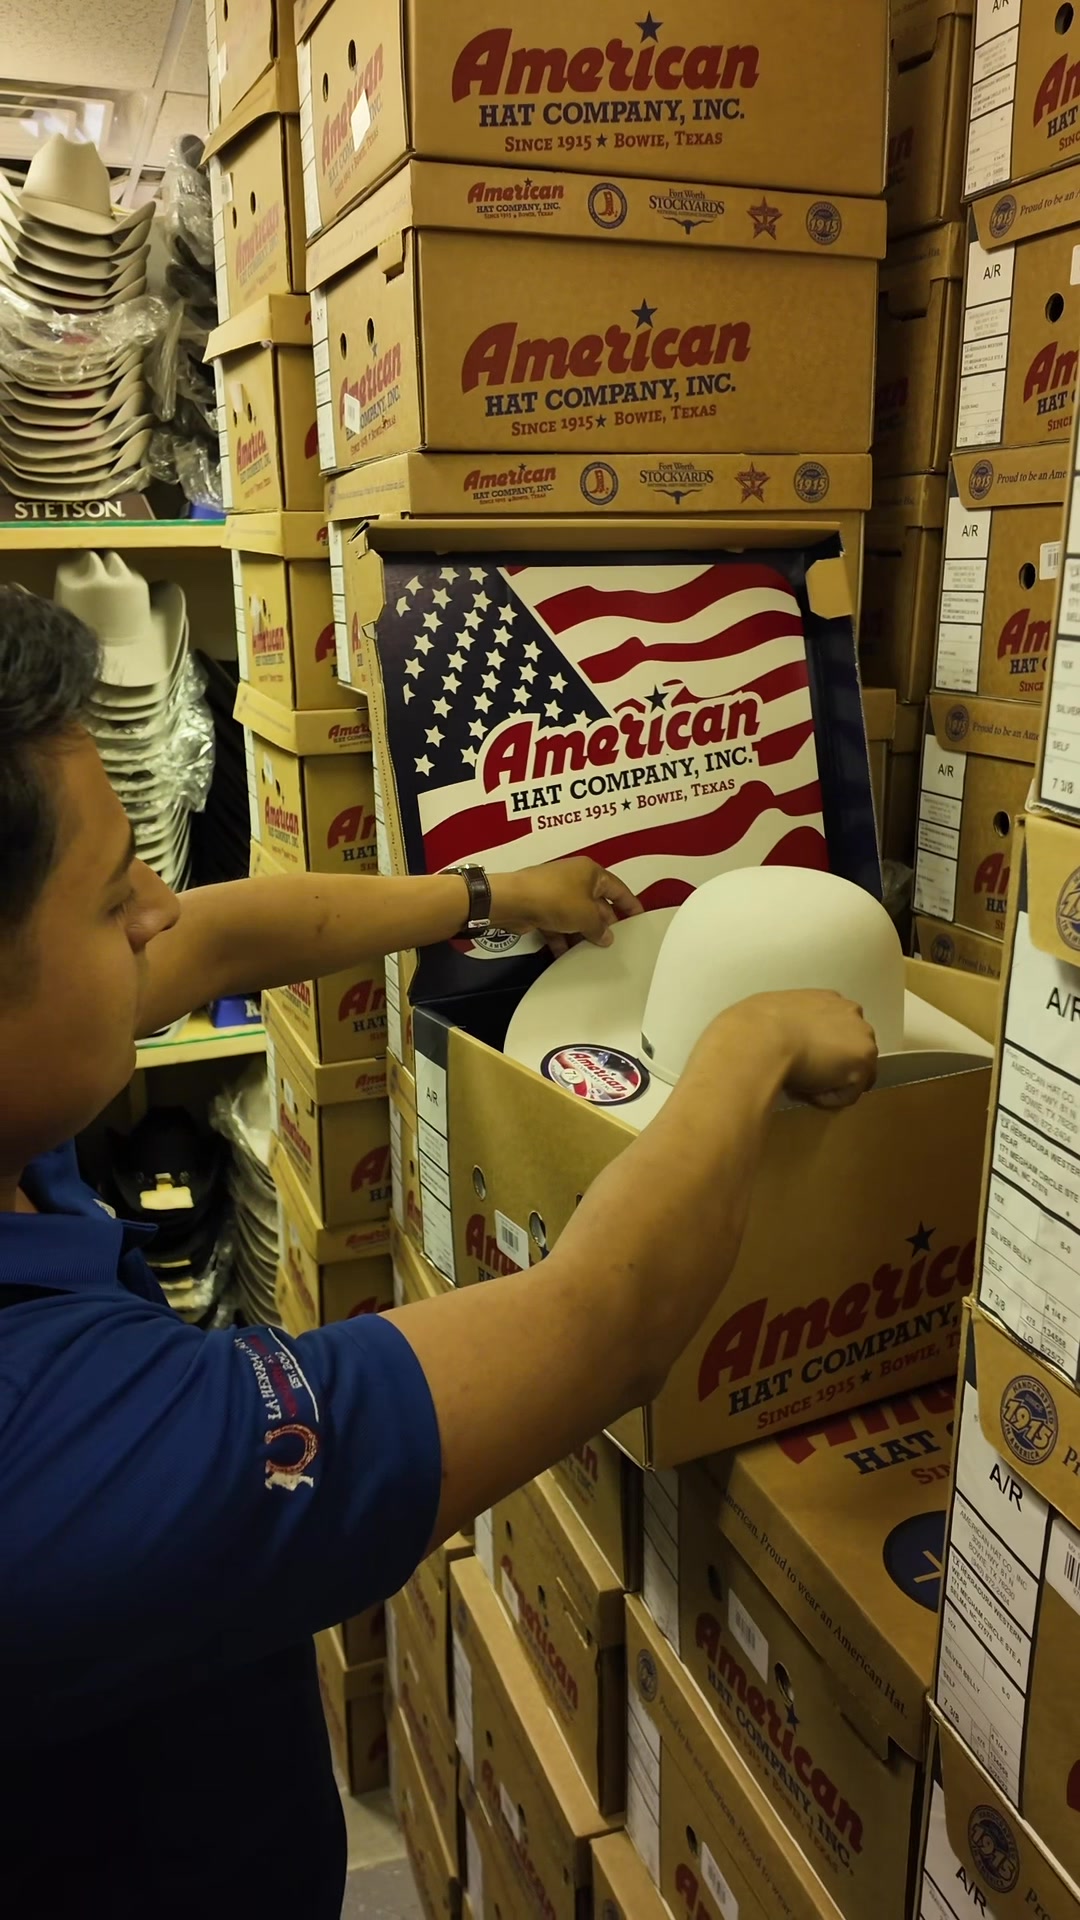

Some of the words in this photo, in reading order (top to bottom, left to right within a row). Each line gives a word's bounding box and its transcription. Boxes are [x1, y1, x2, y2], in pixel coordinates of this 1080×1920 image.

[452, 28, 760, 103] American
[479, 103, 535, 127] HAT
[543, 98, 685, 125] COMPANY,
[692, 98, 745, 121] INC.
[1047, 105, 1078, 139] HAT
[467, 182, 564, 203] American
[649, 195, 725, 215] STOCKYARDS
[669, 188, 683, 199] Fort
[684, 190, 706, 200] Worth
[1019, 199, 1043, 216] Proud
[1044, 199, 1053, 209] to
[1053, 195, 1064, 205] be
[1065, 191, 1075, 201] an
[810, 216, 839, 233] 1915
[983, 263, 1001, 280] A/R
[461, 321, 751, 394] American
[485, 391, 538, 417] HAT
[545, 378, 681, 411] COMPANY,
[685, 373, 736, 397] INC.
[1037, 391, 1068, 416] HAT
[639, 470, 714, 484] STOCKYARDS
[658, 462, 673, 471] Fort
[997, 472, 1018, 484] Proud
[1019, 473, 1026, 482] to
[1027, 472, 1037, 480] be
[463, 467, 556, 492] American
[798, 477, 826, 491] 1915
[971, 473, 992, 489] 1915
[14, 501, 126, 519] STETSON
[962, 525, 978, 537] A/R
[1010, 658, 1038, 674] HAT
[972, 722, 992, 735] Proud
[993, 725, 1002, 735] to
[1003, 726, 1012, 735] be
[1012, 729, 1021, 737] an
[483, 698, 760, 794] American
[511, 784, 563, 812] HAT
[569, 756, 700, 800] COMPANY,
[705, 746, 753, 772] INC.
[937, 763, 954, 778] A/R
[1052, 778, 1058, 790] 7
[537, 811, 582, 830] SINCE
[585, 802, 617, 820] 1915
[636, 790, 688, 809] BOWIE,
[691, 779, 735, 797] TEXAS
[489, 935, 517, 948] AMERICA
[1011, 1061, 1045, 1087] AMERICAN
[1047, 1082, 1061, 1095] HAT
[426, 1086, 439, 1107] A/R
[1046, 1107, 1056, 1119] TX
[1000, 1132, 1018, 1148] WEAR
[1021, 1171, 1031, 1182] NC
[1051, 1151, 1080, 1178] WESTER
[1039, 1170, 1063, 1193] CIRCLE
[1064, 1188, 1079, 1203] STE
[991, 1227, 1012, 1249] SILVER
[1013, 1244, 1032, 1264] BELLY
[988, 1256, 1003, 1272] SELF
[988, 1288, 994, 1299] 7
[995, 1294, 1006, 1311] 3/8
[728, 1368, 792, 1416] HAT
[801, 1301, 958, 1384] COMPANY,
[1041, 1344, 1065, 1367] 5/25/22
[757, 1392, 811, 1430] SINCE
[816, 1376, 856, 1401] 1915
[1003, 1399, 1054, 1449] 1915
[844, 1429, 941, 1475] HAT
[1009, 1436, 1040, 1459] AMERICA
[989, 1463, 1023, 1512] A/R
[960, 1510, 989, 1547] AMERICAN
[990, 1544, 1002, 1560] HAT
[952, 1566, 968, 1588] WEAR
[990, 1565, 998, 1580] TX
[950, 1585, 968, 1613] SELMA,
[969, 1609, 978, 1623] NC
[960, 1562, 993, 1608] HERRADURA
[994, 1606, 1022, 1644] WESTERN
[760, 1532, 787, 1569] Proud
[787, 1566, 798, 1585] to
[798, 1580, 820, 1612] wear
[820, 1610, 833, 1629] an
[833, 1625, 883, 1689] American
[884, 1680, 908, 1719] Hat.
[984, 1616, 1004, 1645] CIRCLE
[1005, 1643, 1016, 1660] STE
[945, 1645, 963, 1672] SILVER
[963, 1669, 980, 1694] BELLY
[949, 1705, 960, 1723] 3/8
[695, 1612, 863, 1856] American
[736, 1705, 813, 1826] COMPANY,
[817, 1813, 854, 1877] INC.
[955, 1866, 987, 1917] A/R
